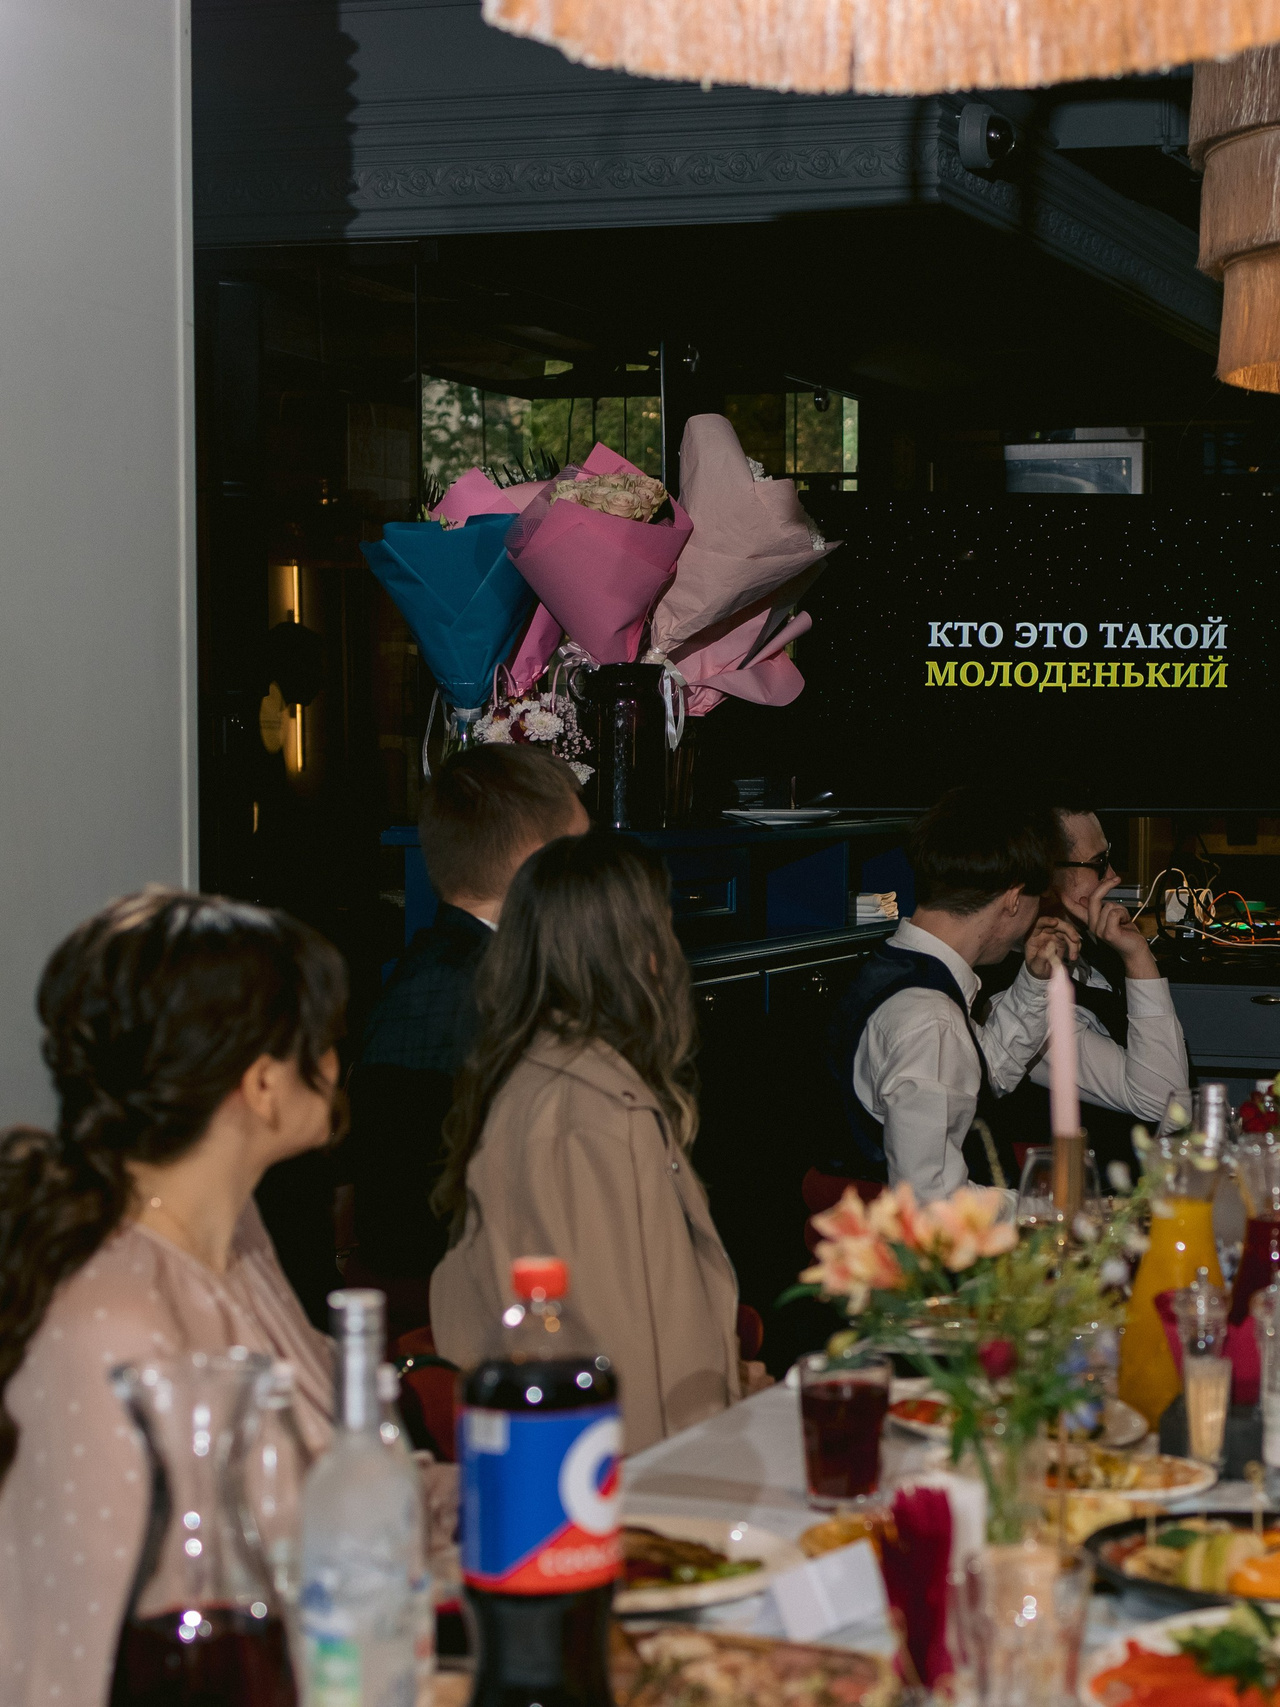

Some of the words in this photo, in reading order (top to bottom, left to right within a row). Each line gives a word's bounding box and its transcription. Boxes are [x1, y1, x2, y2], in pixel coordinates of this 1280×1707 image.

[928, 621, 1003, 649] КТО
[1015, 621, 1088, 649] ЭТО
[1099, 616, 1228, 650] ТАКОЙ
[925, 655, 1229, 692] МОЛОДЕНЬКИЙ
